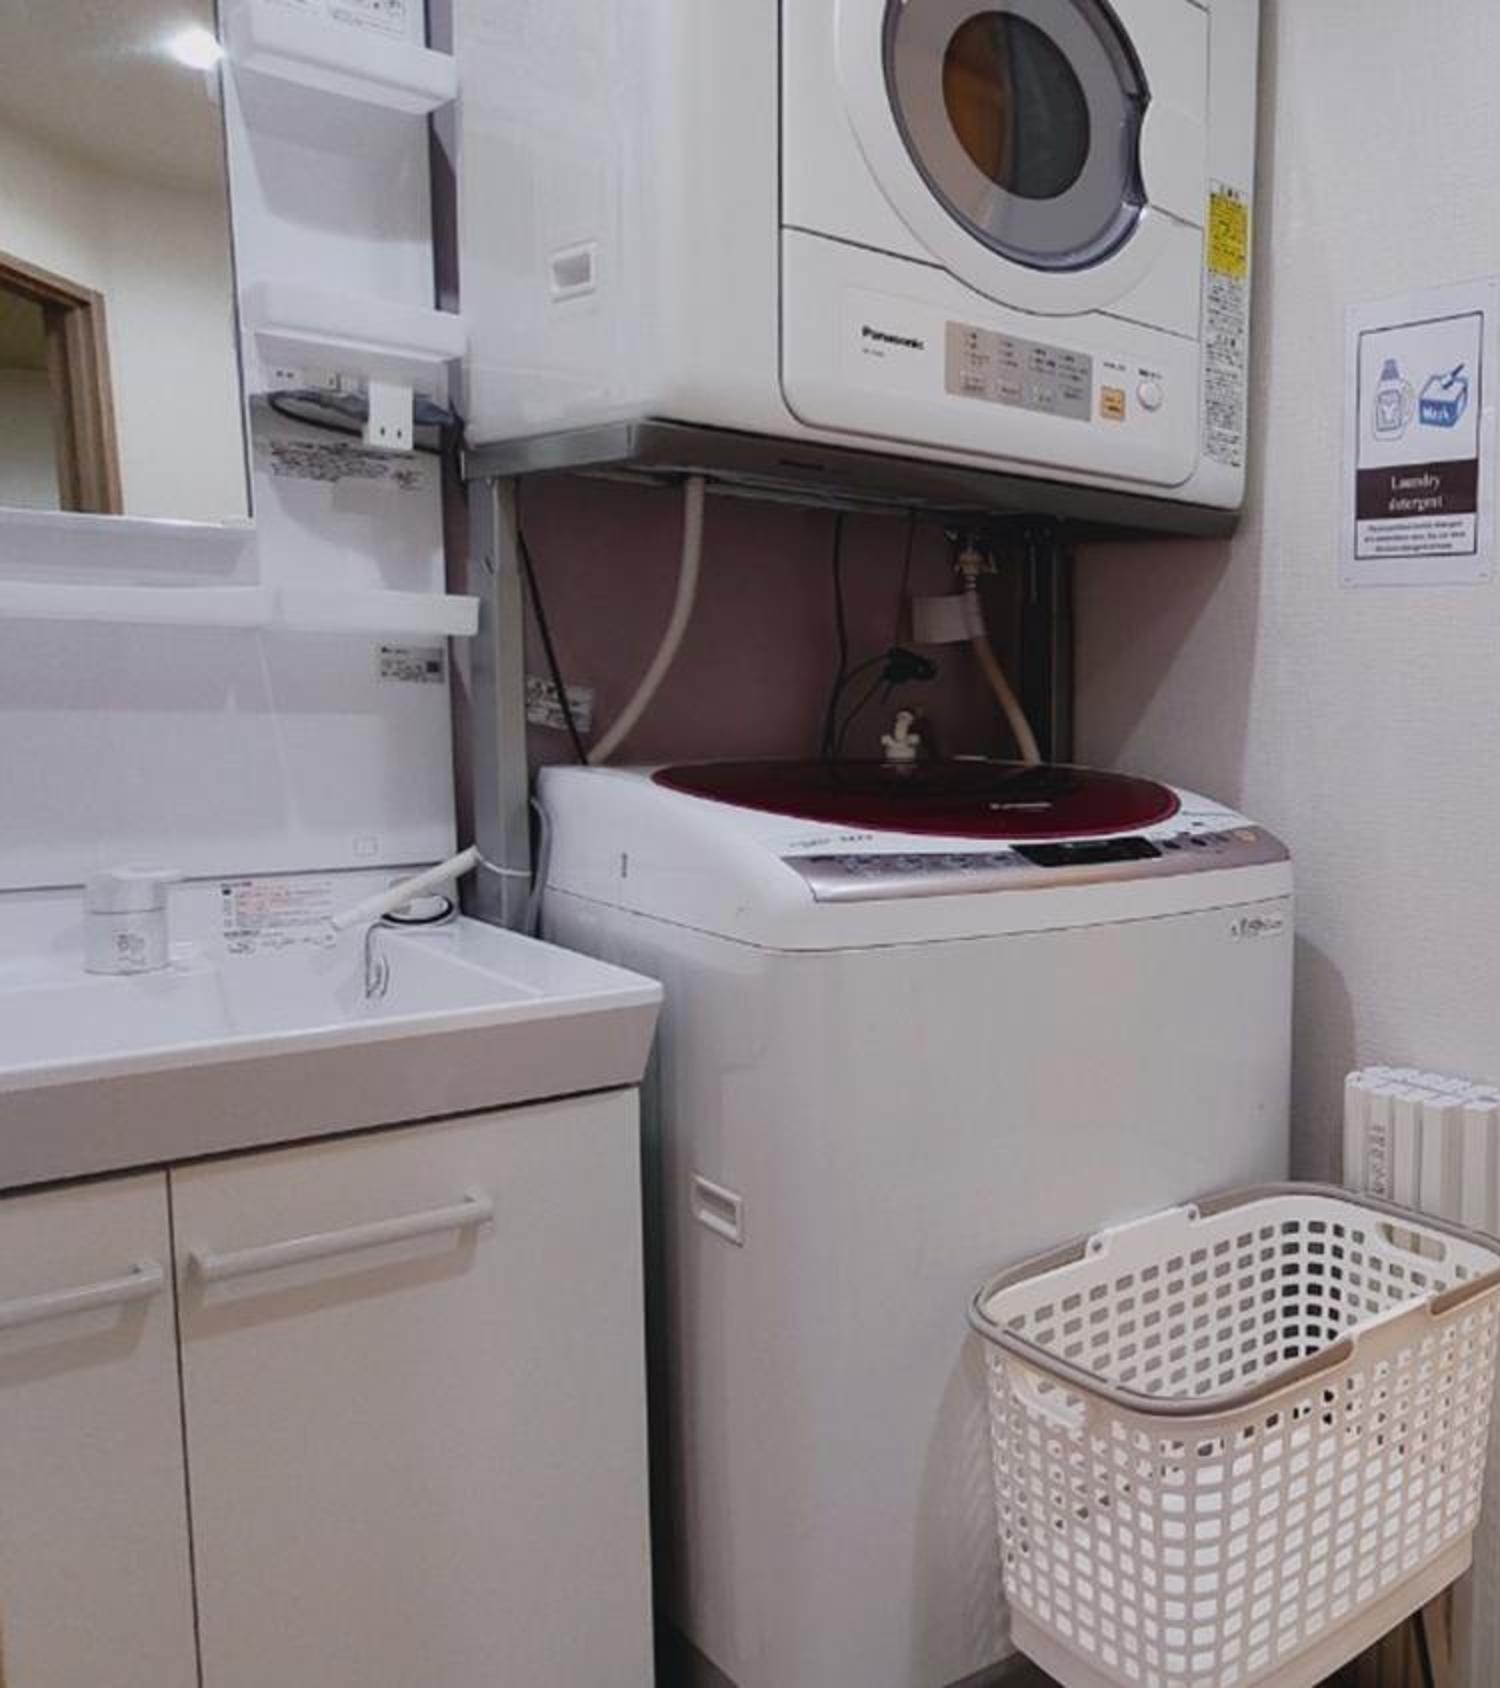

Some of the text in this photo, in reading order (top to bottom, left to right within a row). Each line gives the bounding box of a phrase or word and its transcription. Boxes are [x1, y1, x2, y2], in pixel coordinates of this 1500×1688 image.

[861, 325, 925, 351] Panasonic
[1391, 472, 1441, 492] Laundry
[1388, 495, 1443, 512] detergent
